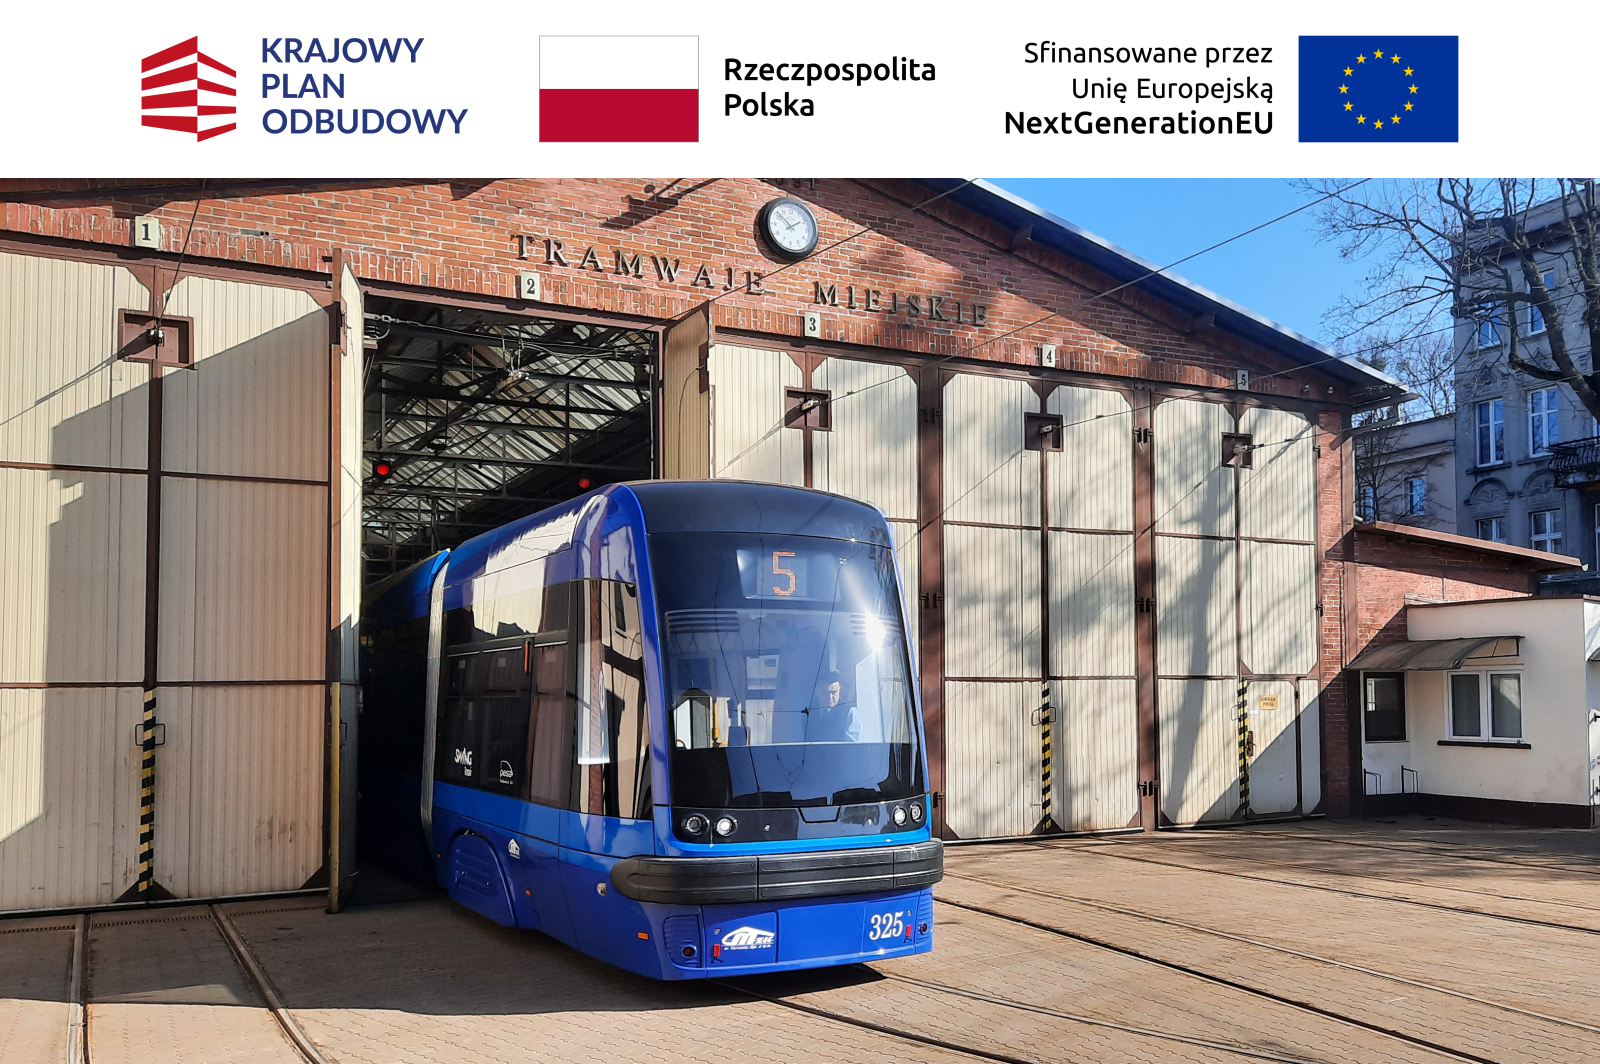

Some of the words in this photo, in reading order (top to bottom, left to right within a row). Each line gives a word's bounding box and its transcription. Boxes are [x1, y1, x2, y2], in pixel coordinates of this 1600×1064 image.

[141, 223, 151, 241] 1
[510, 233, 765, 296] TRAMWAJE
[526, 278, 536, 295] 2
[812, 280, 989, 327] MIEJSKIE
[809, 316, 817, 332] 3
[1046, 350, 1053, 364] 4
[1240, 373, 1247, 387] 5
[772, 551, 797, 597] 5
[454, 748, 473, 766] SWING
[499, 769, 514, 778] pesa
[868, 910, 905, 941] 325
